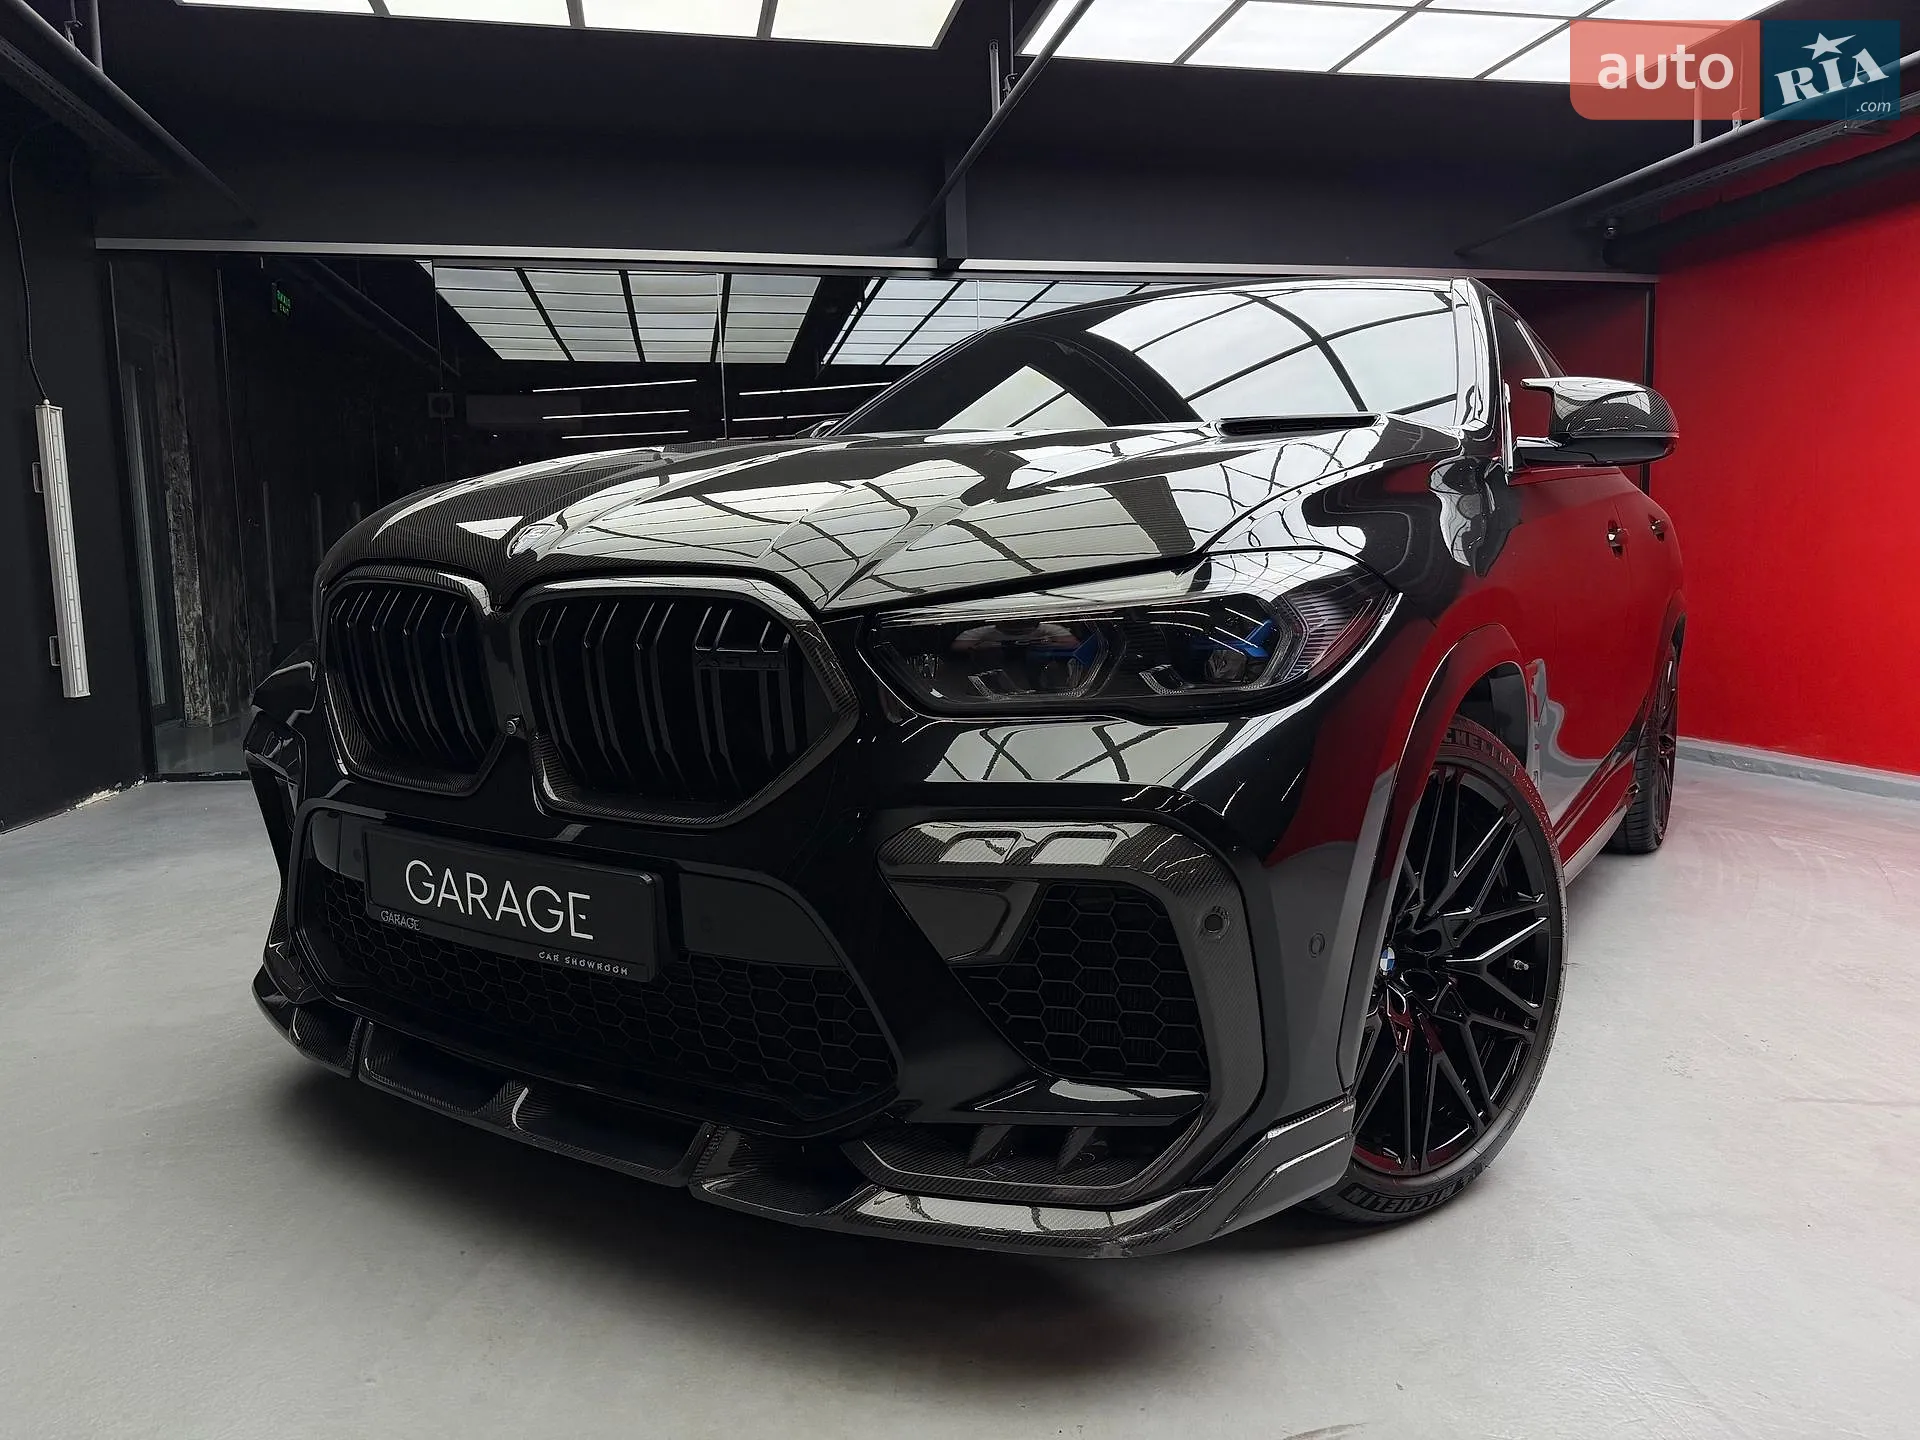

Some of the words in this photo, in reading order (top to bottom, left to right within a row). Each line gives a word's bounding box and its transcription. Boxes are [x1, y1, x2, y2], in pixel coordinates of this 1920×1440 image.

[405, 859, 594, 940] GARAGE
[380, 910, 421, 931] GARAGE
[538, 951, 560, 962] CAR
[564, 956, 629, 976] SHOWROOM
[1346, 1185, 1456, 1212] MICHELIN
